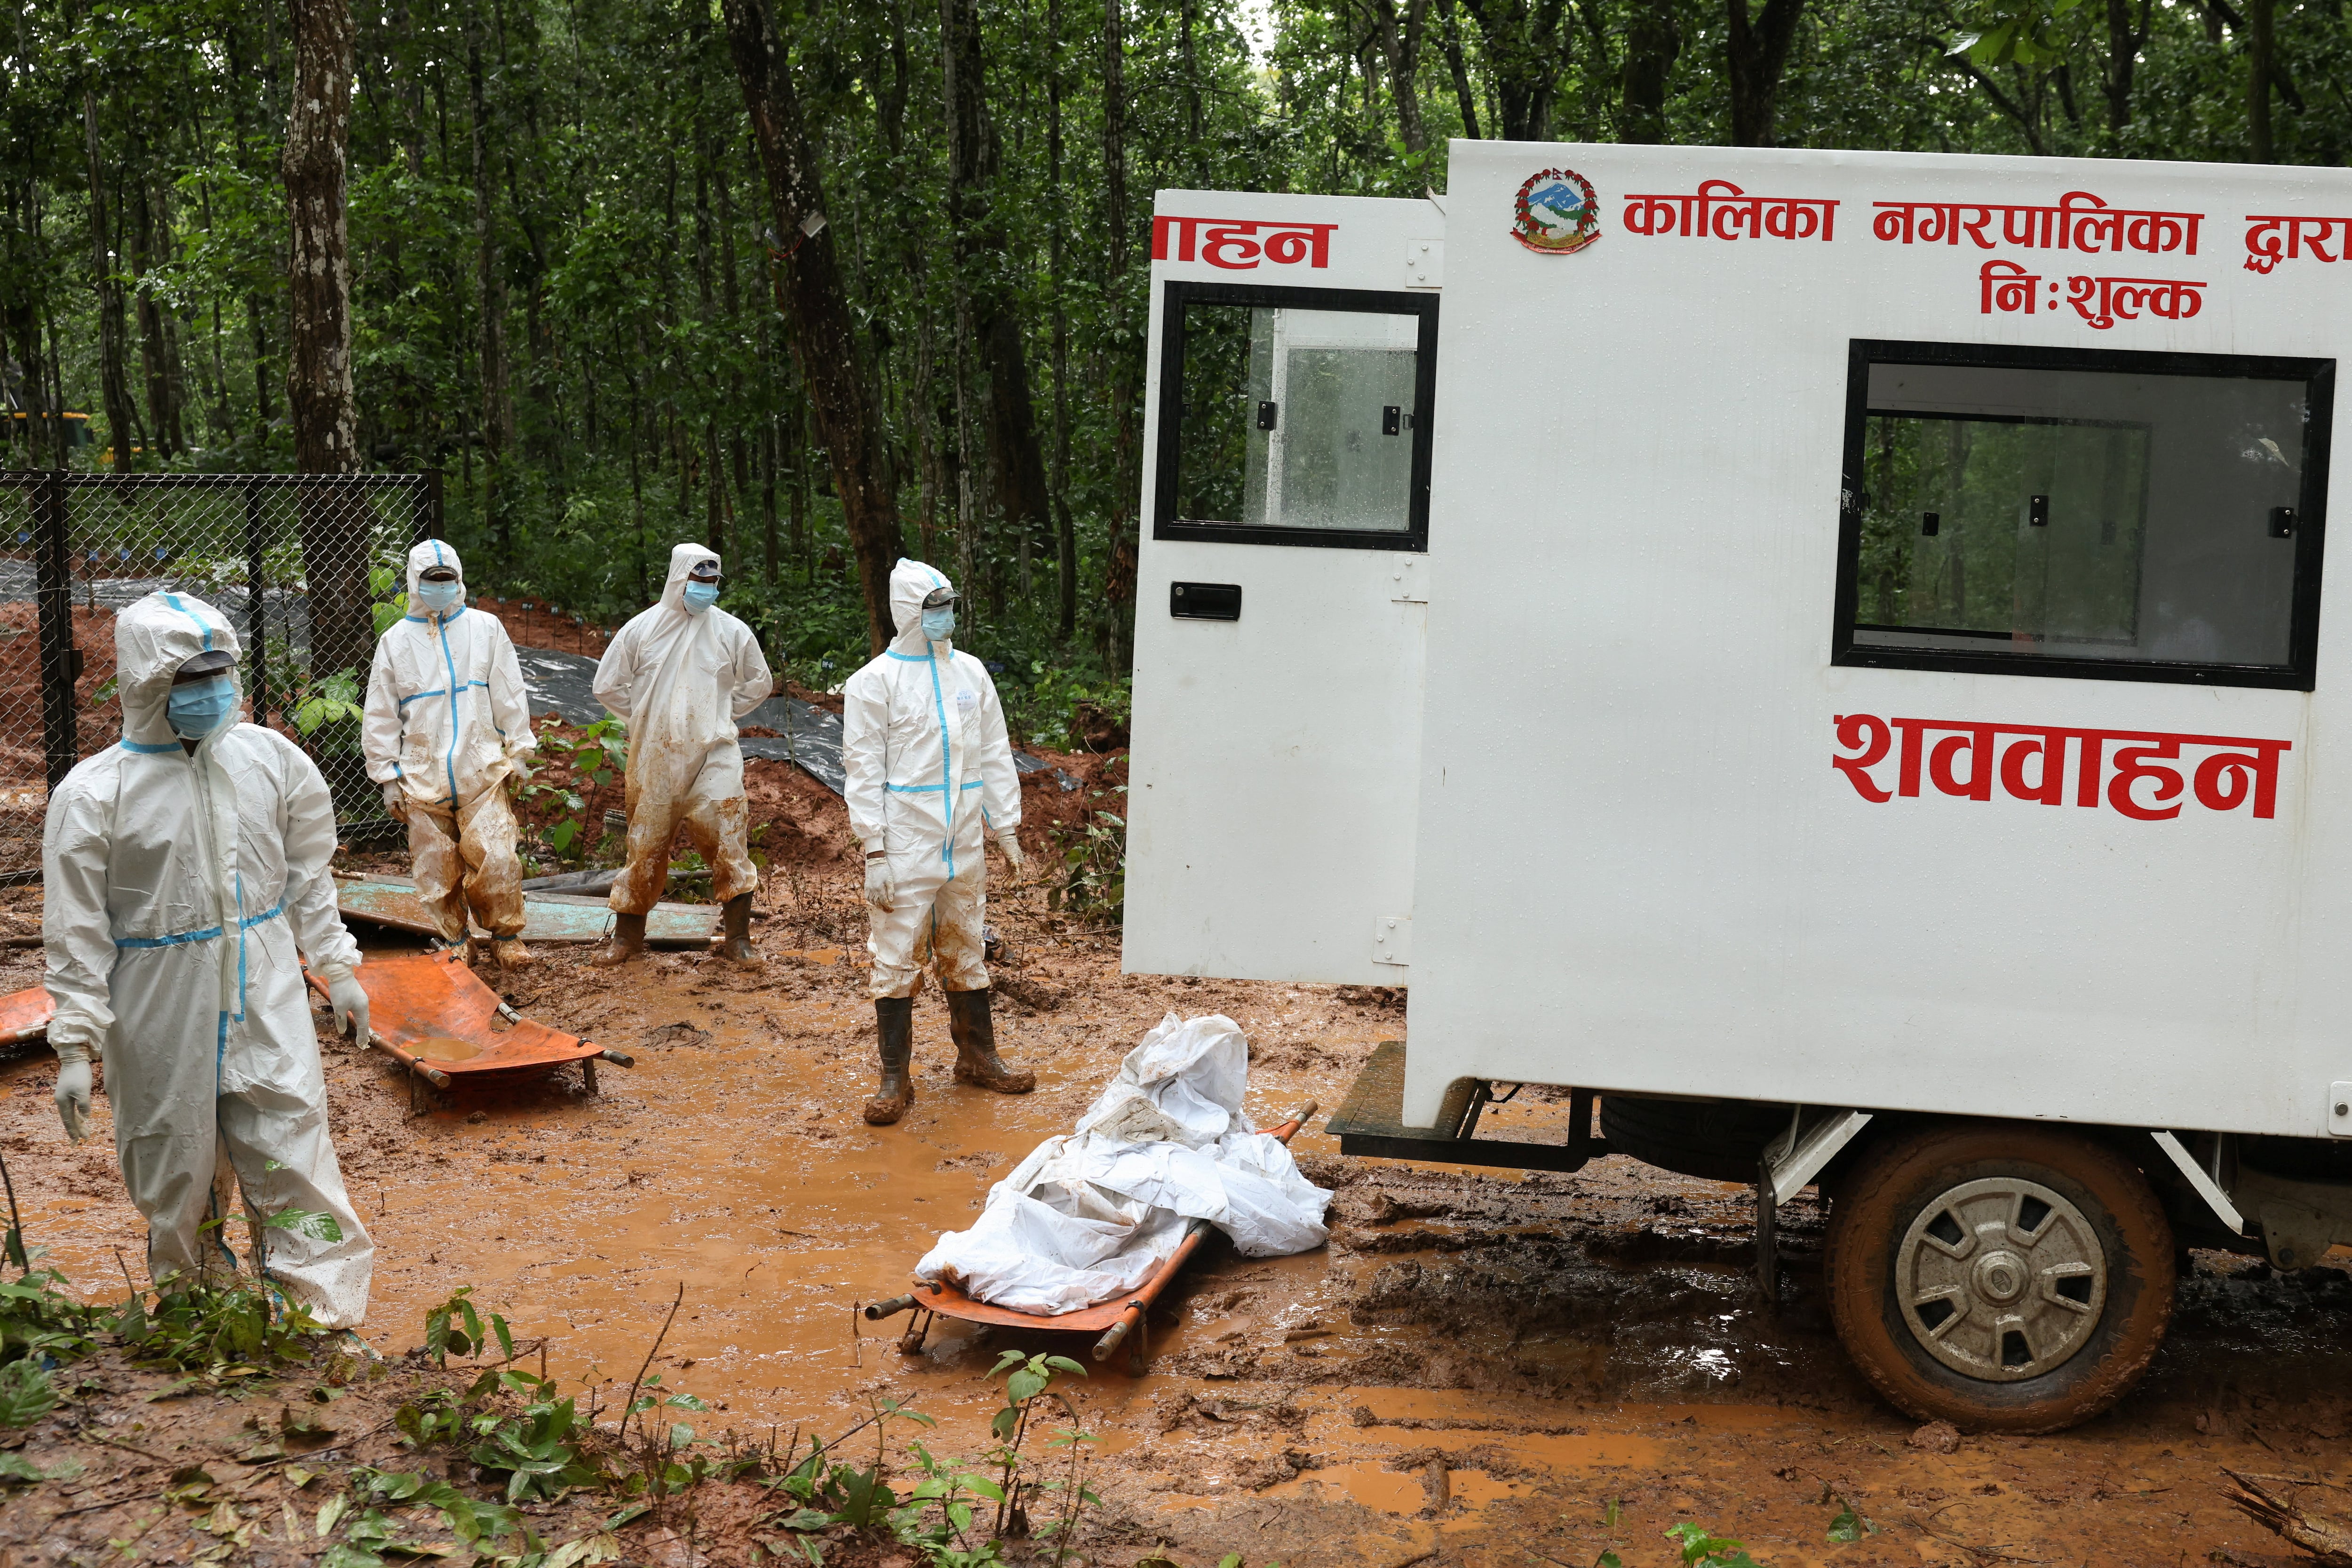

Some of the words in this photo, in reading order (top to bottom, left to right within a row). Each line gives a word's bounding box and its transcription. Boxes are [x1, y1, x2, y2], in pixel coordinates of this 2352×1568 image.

[1624, 179, 1840, 241] कालिका
[1873, 191, 2205, 255] नगरपालिका
[1833, 714, 2292, 821] शववाहन
